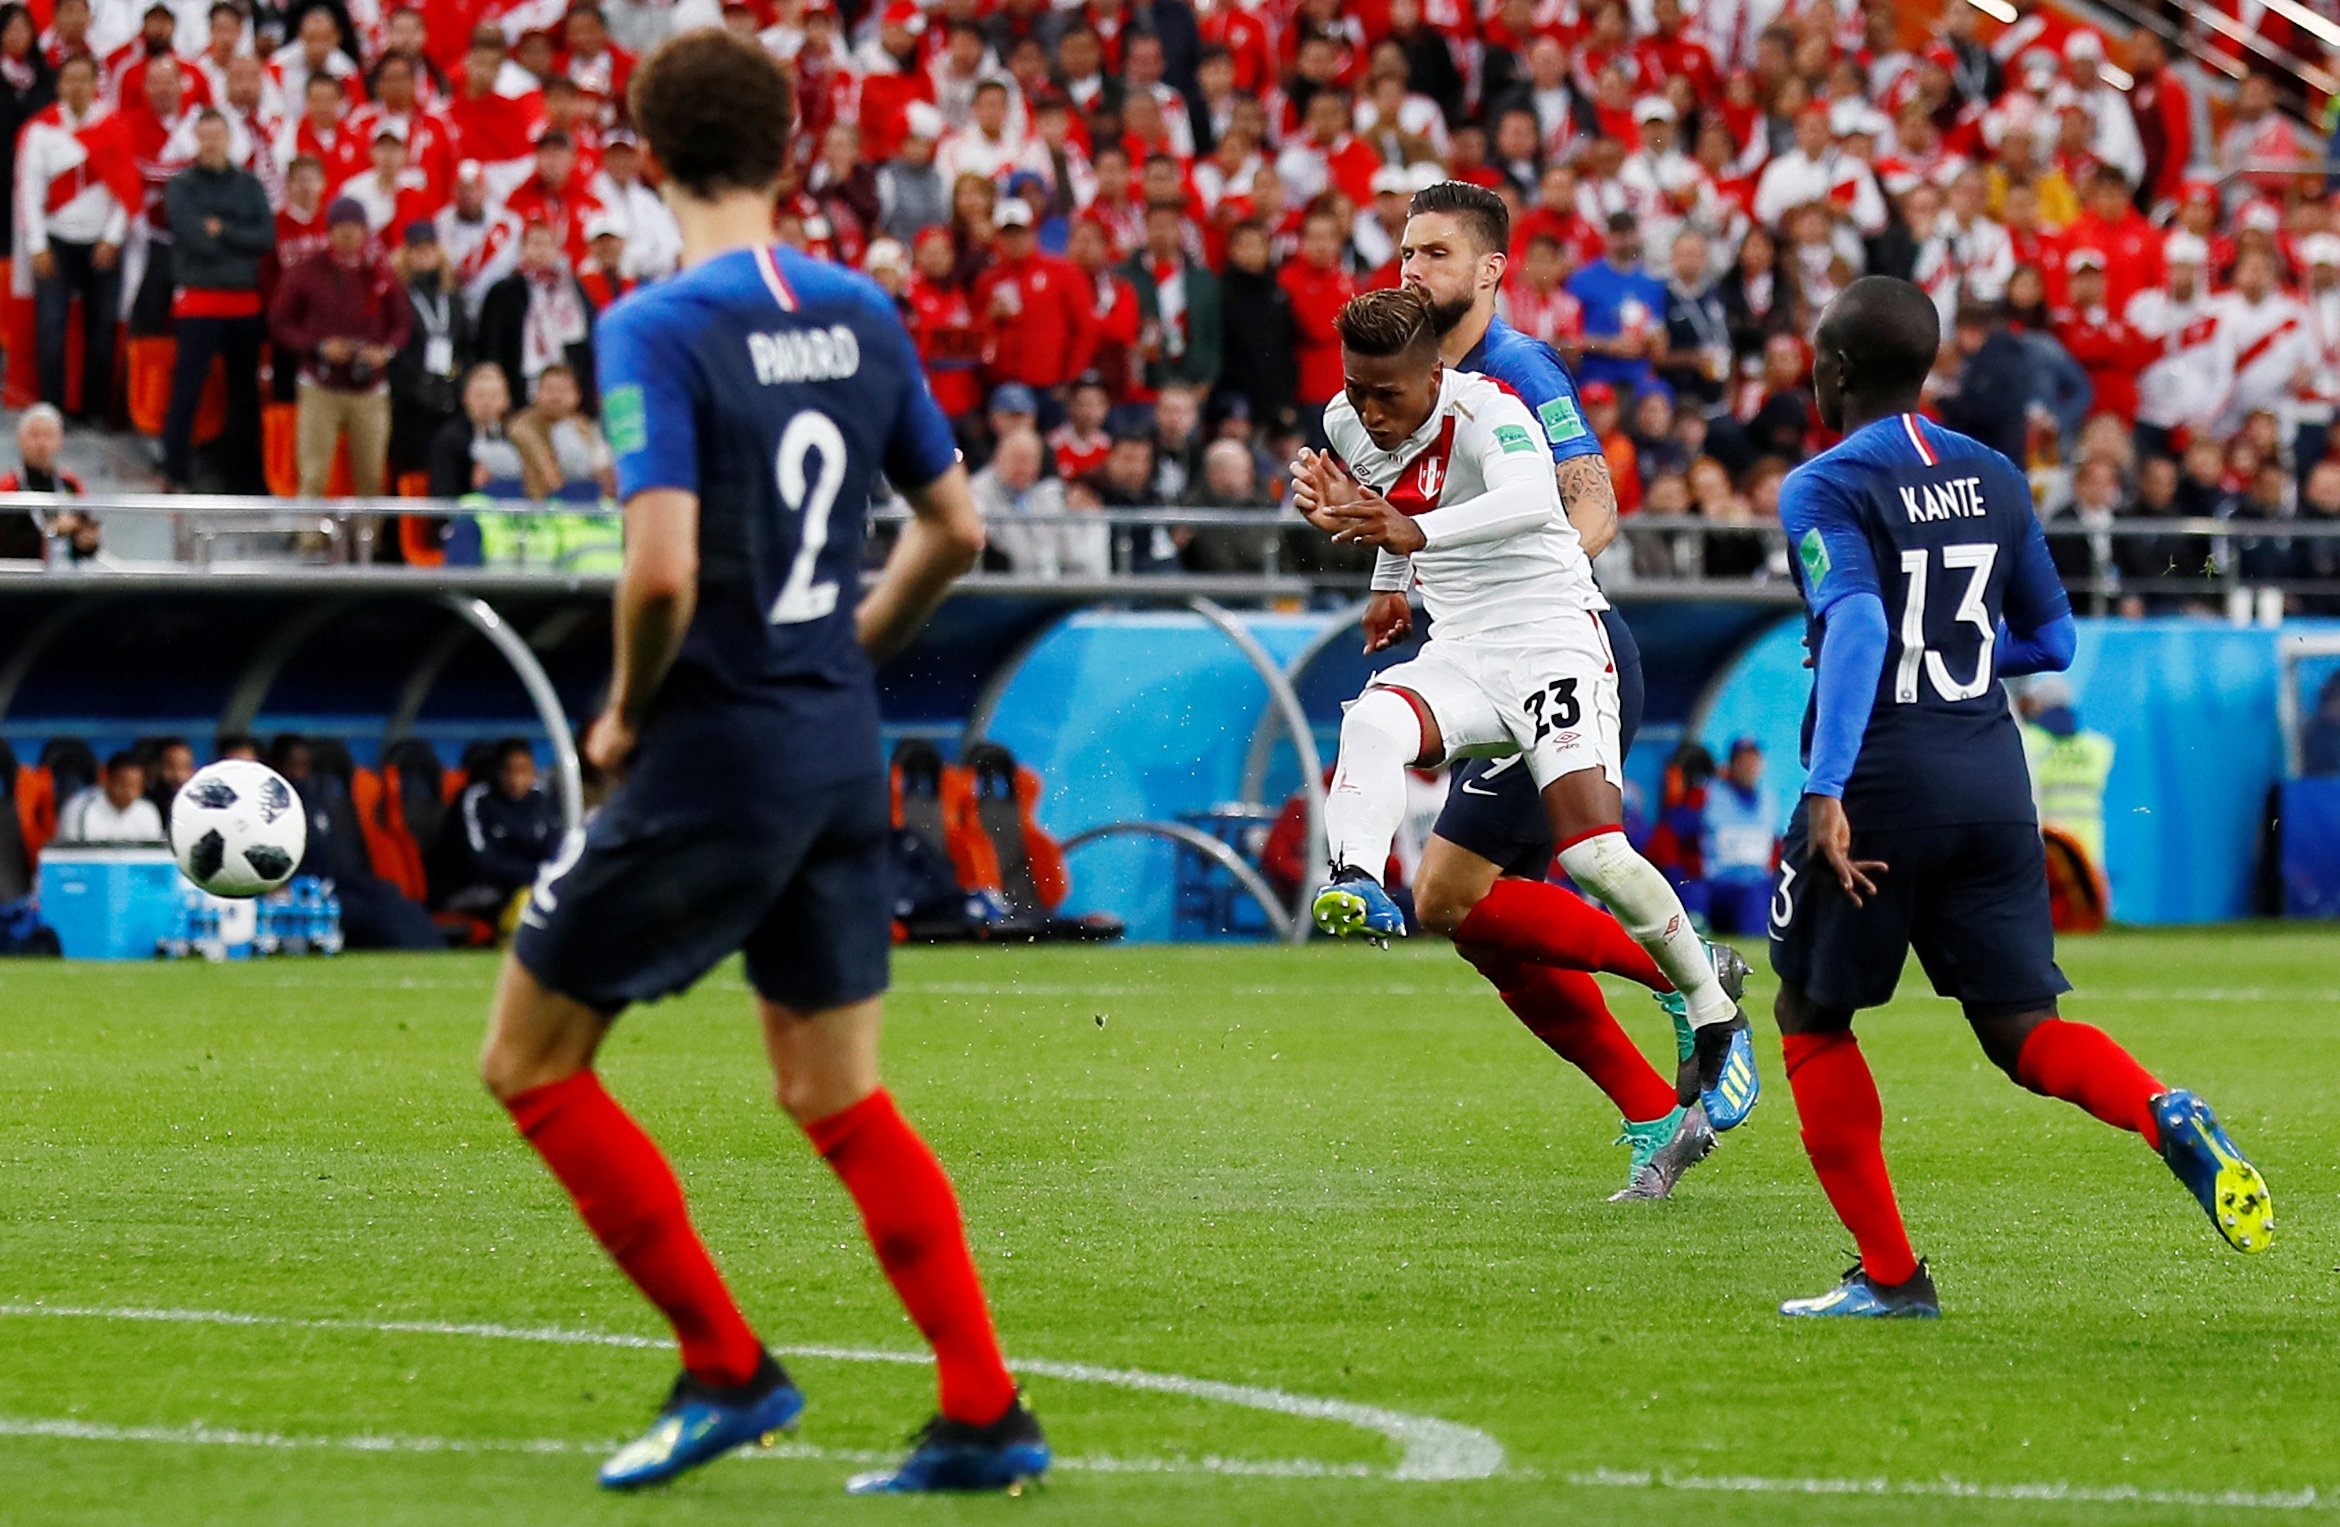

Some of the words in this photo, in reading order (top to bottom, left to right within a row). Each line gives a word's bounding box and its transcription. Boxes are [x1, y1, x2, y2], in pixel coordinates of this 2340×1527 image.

[768, 409, 847, 625] 2
[1899, 476, 1987, 523] KANTE
[1895, 543, 1999, 703] 13
[1523, 677, 1581, 744] 23
